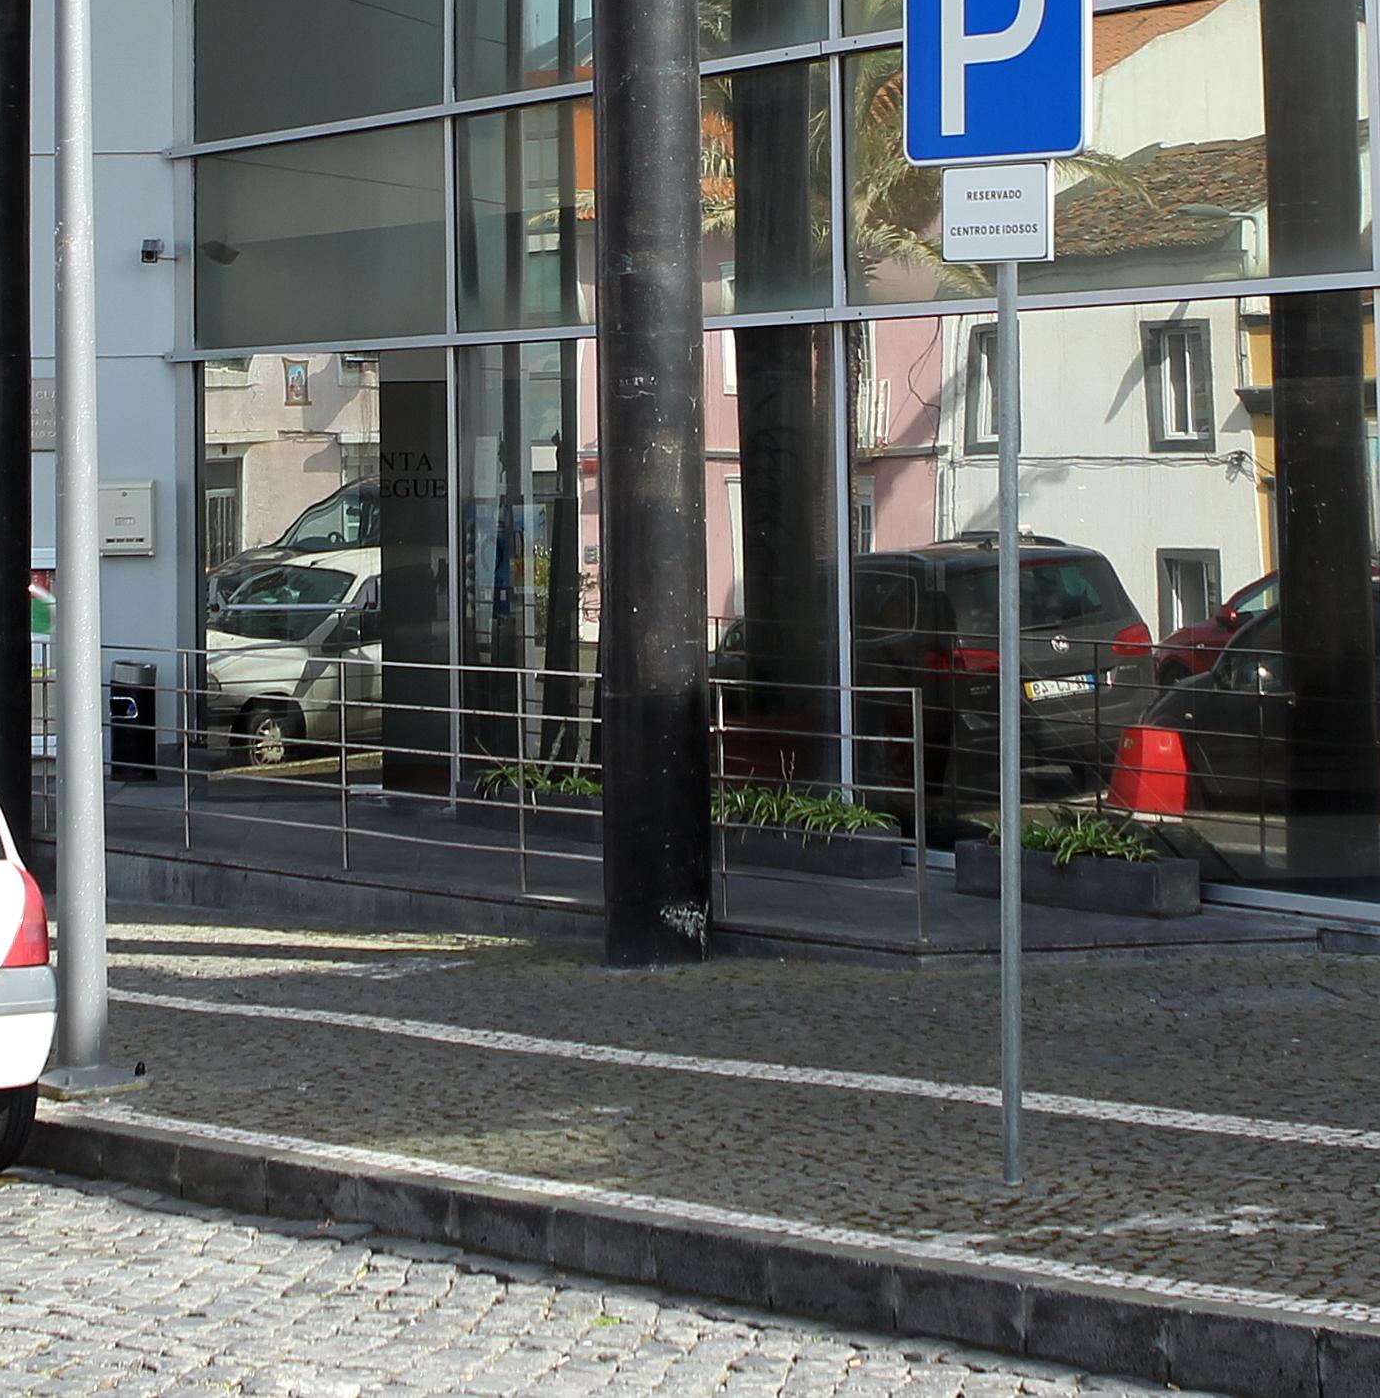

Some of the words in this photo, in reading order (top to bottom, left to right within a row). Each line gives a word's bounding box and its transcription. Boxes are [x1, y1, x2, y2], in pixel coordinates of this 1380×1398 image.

[966, 189, 1022, 201] RESERVADO
[950, 225, 988, 237] CENTRO
[988, 224, 1001, 235] DE
[1002, 223, 1038, 234] IDOSOS
